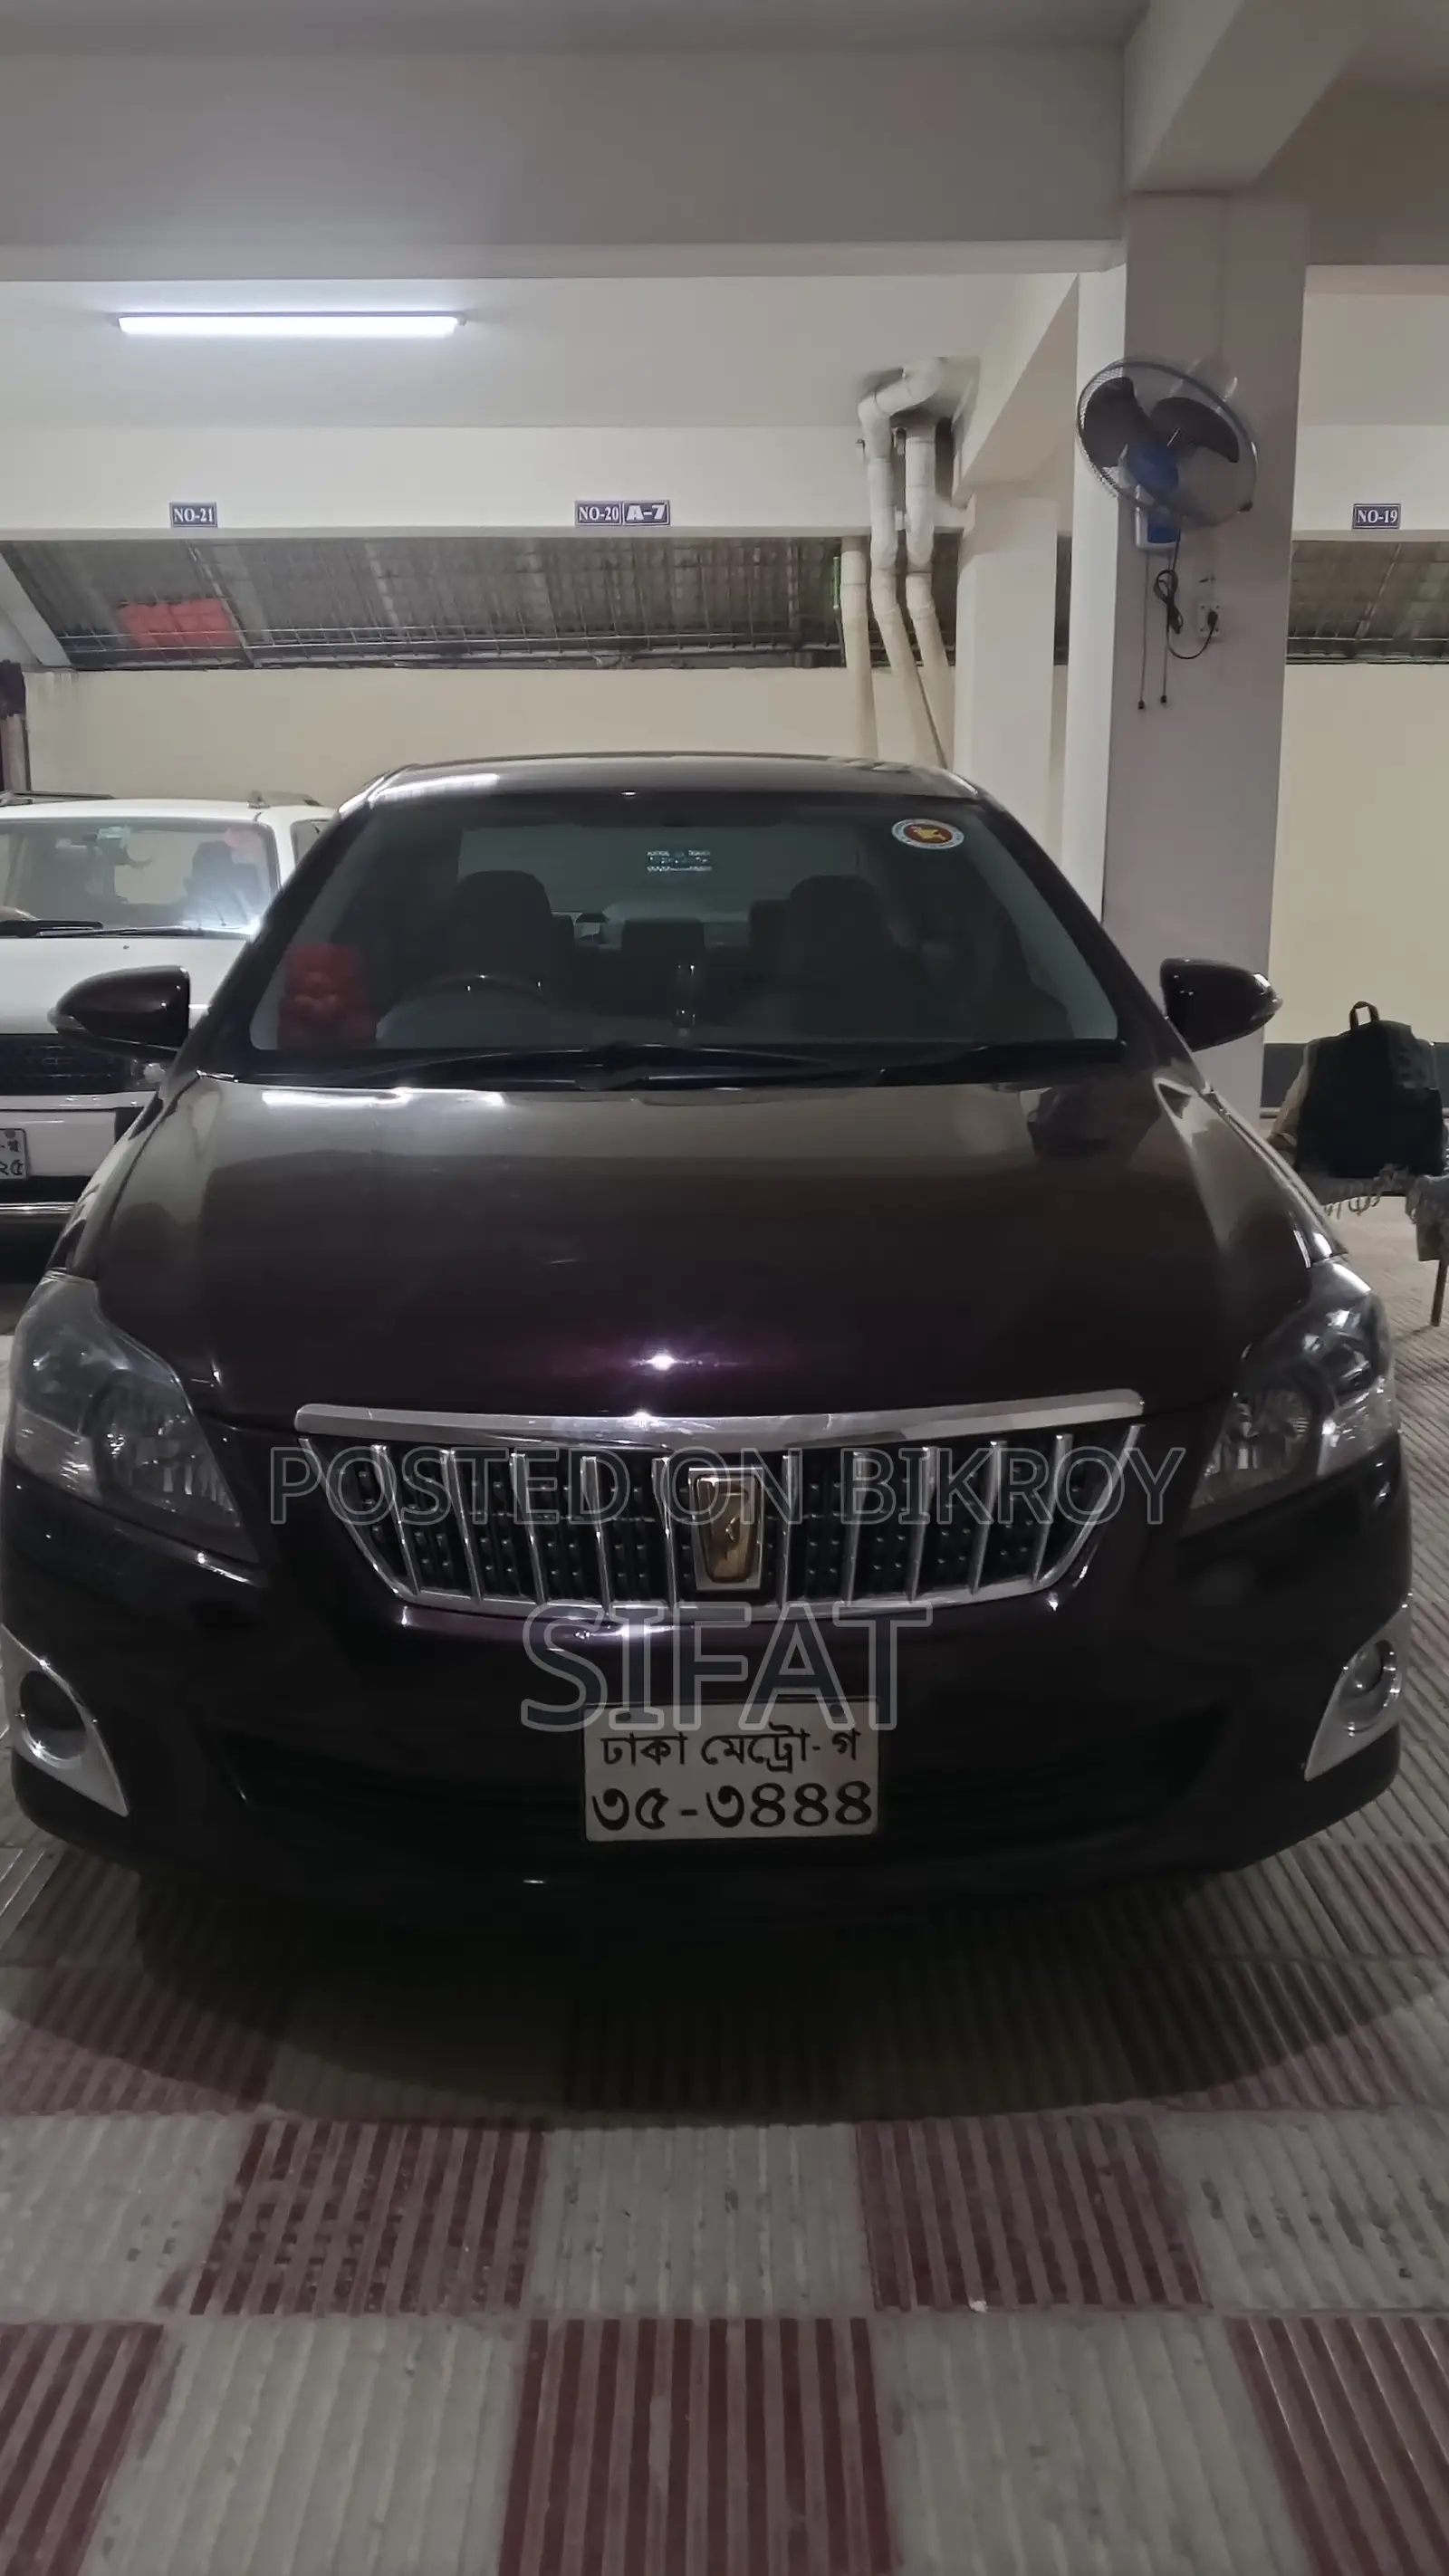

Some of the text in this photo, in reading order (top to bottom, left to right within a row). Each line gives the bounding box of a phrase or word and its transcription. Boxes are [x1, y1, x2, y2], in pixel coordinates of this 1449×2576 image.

[173, 507, 214, 522] NO-21
[579, 506, 619, 521] NO-20
[626, 504, 667, 521] A-7
[1358, 509, 1398, 523] NO-19
[600, 1732, 688, 1766] ঢাকা
